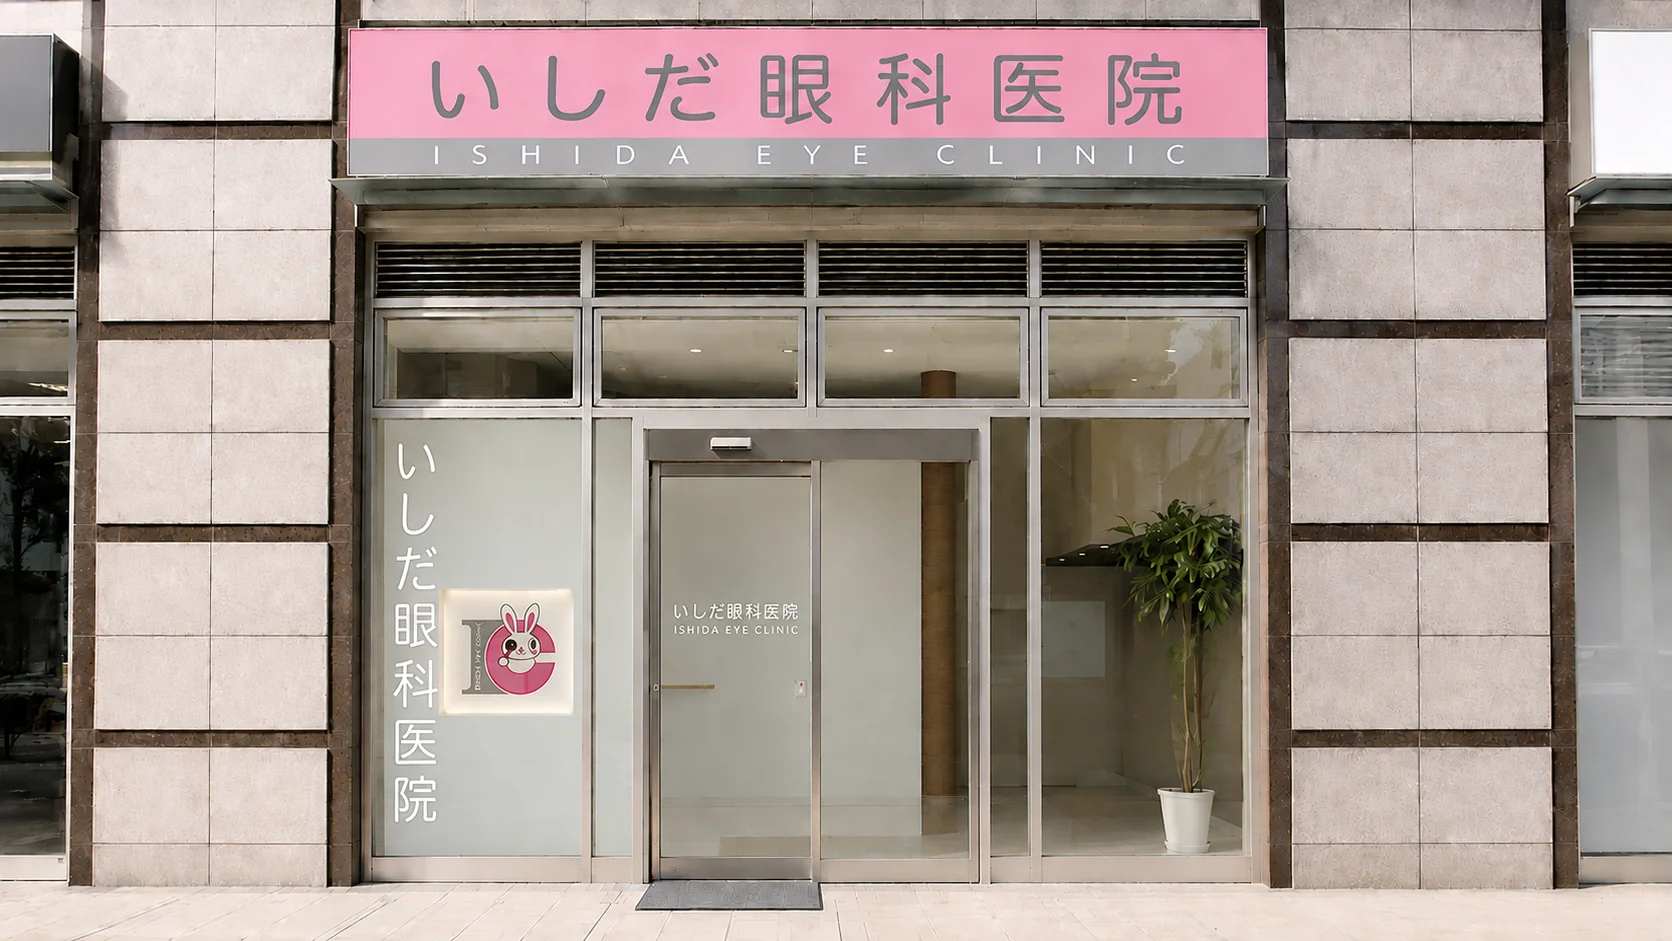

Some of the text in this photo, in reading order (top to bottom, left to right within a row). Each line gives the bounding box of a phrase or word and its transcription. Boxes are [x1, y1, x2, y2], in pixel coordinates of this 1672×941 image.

[431, 52, 1183, 126] いしだ眼科医院
[434, 144, 1186, 165] ISHIDA EYE CLINIC
[674, 602, 799, 621] いしだ眼科医院
[393, 442, 438, 823] いしだ眼科医院
[674, 625, 799, 635] ISHIDA EYE CLINIC
